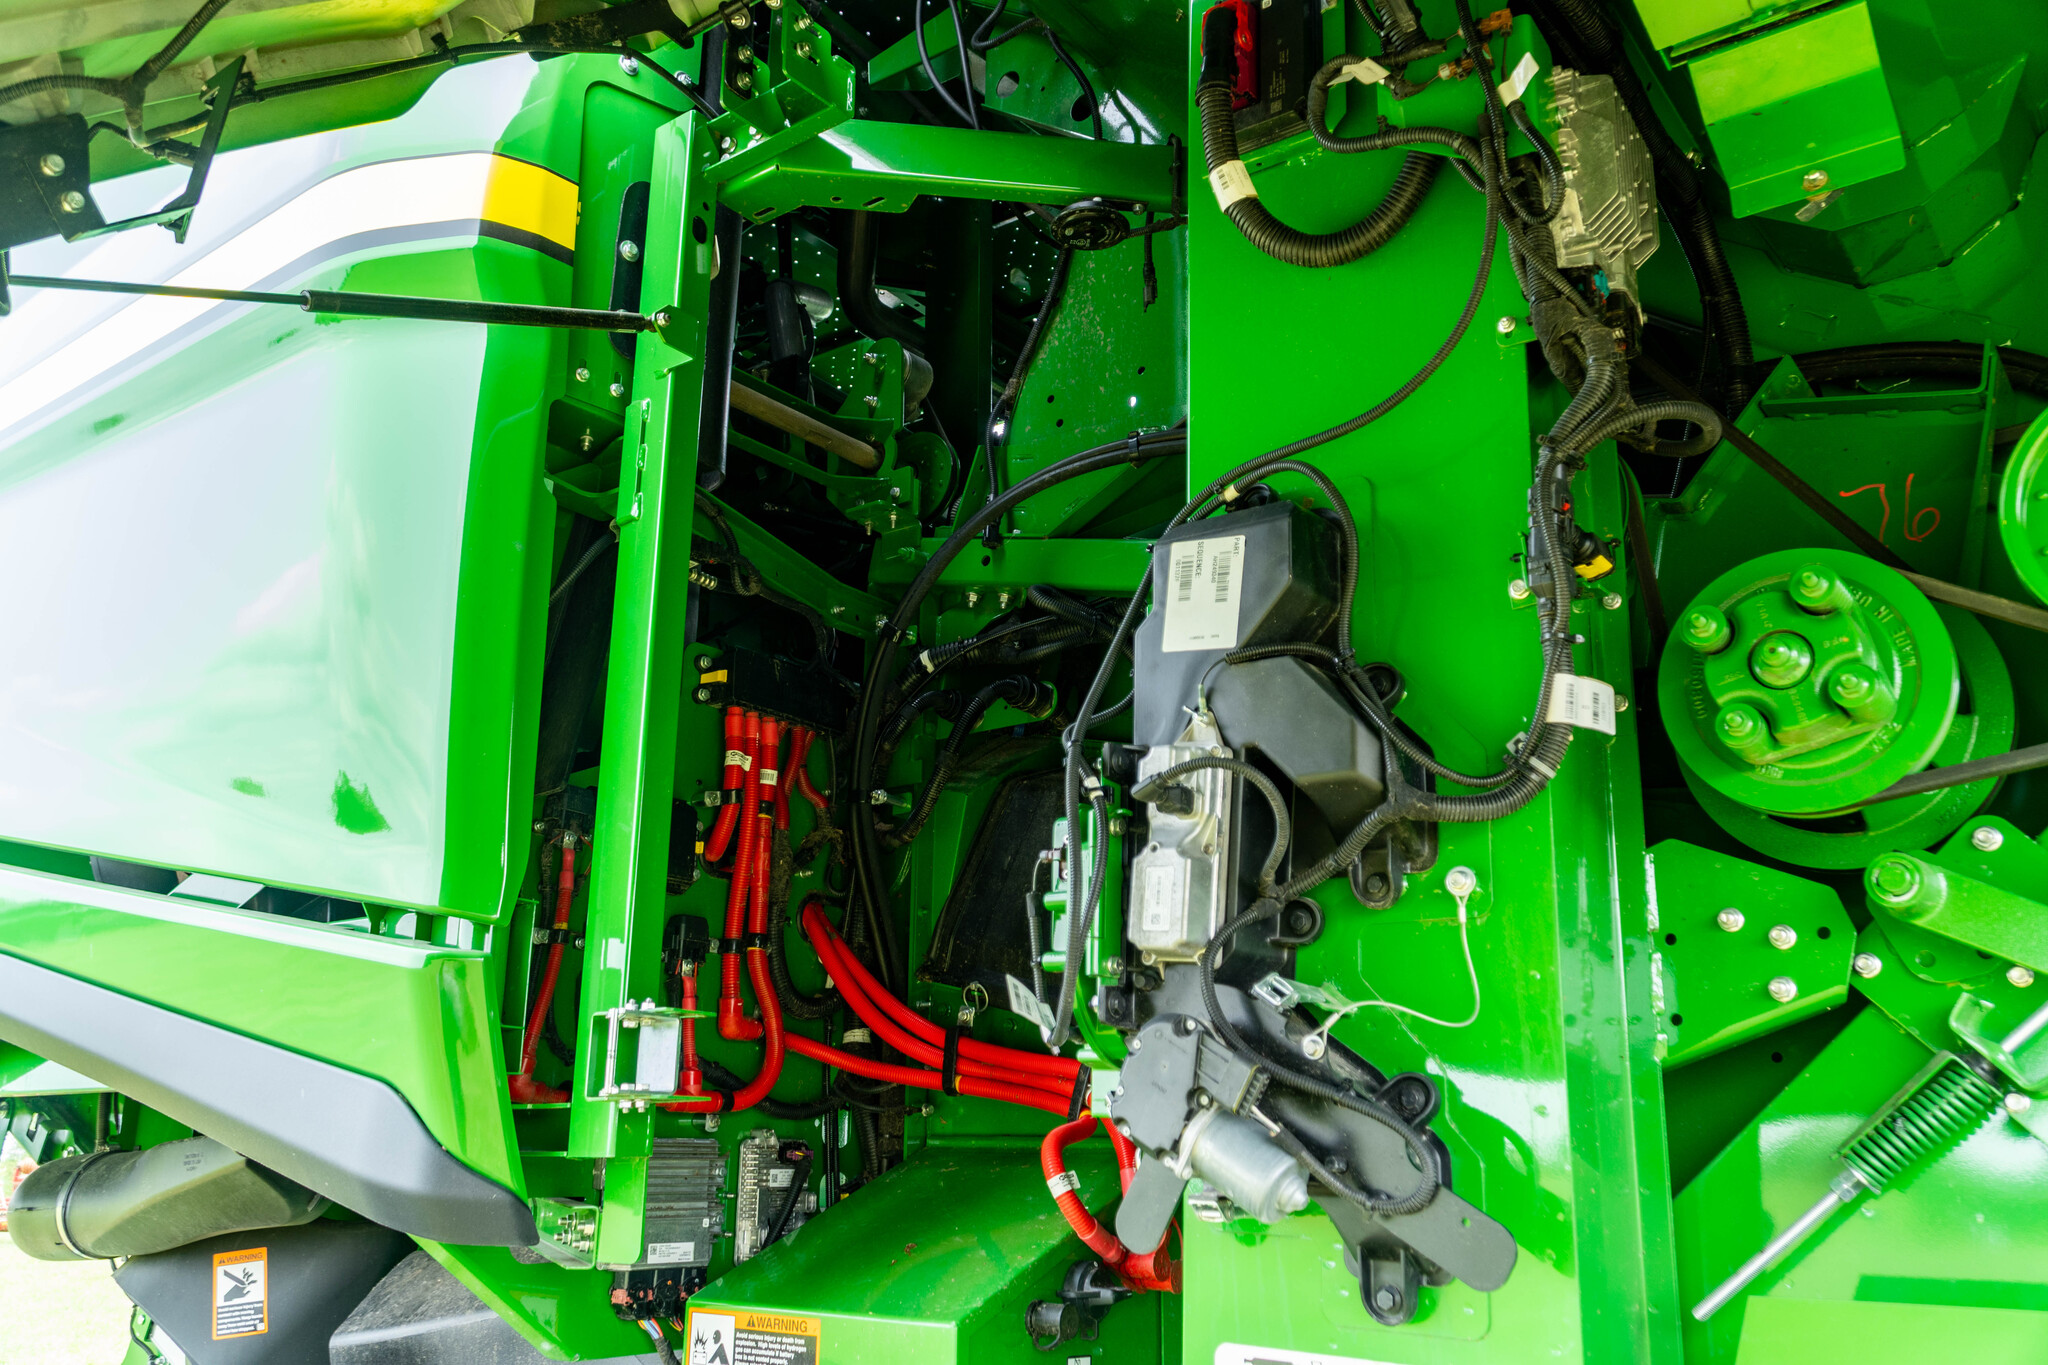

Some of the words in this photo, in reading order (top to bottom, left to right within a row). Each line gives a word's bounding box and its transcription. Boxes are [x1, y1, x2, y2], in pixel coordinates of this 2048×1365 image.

[1839, 473, 1941, 548] 76
[1195, 541, 1204, 580] SEQUENCE:
[226, 1252, 263, 1263] WARNING
[756, 1316, 807, 1332] WARNING
